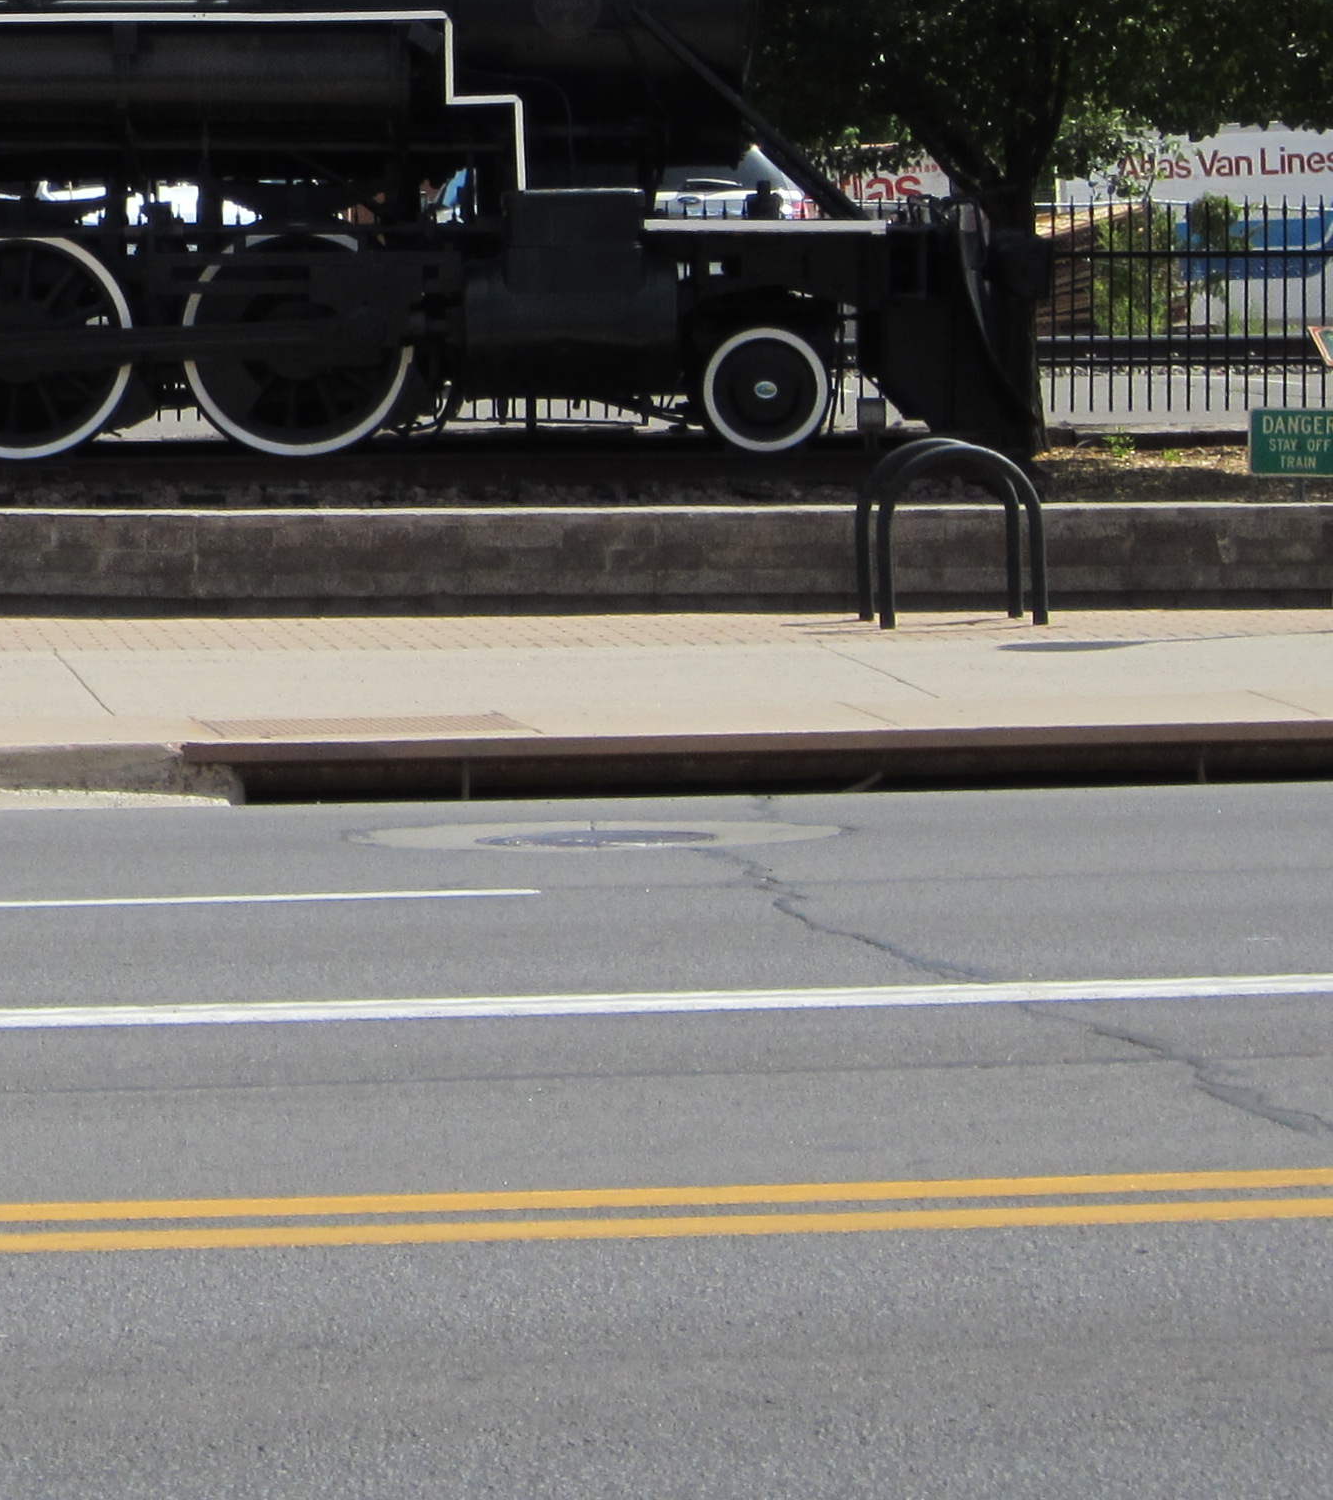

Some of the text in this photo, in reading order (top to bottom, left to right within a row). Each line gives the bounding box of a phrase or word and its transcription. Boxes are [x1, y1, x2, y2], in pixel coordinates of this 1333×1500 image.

[1196, 149, 1253, 178] Van
[1262, 415, 1333, 434] DANGER
[1269, 438, 1332, 452] STAY OFF
[1280, 455, 1317, 469] TRAIN
